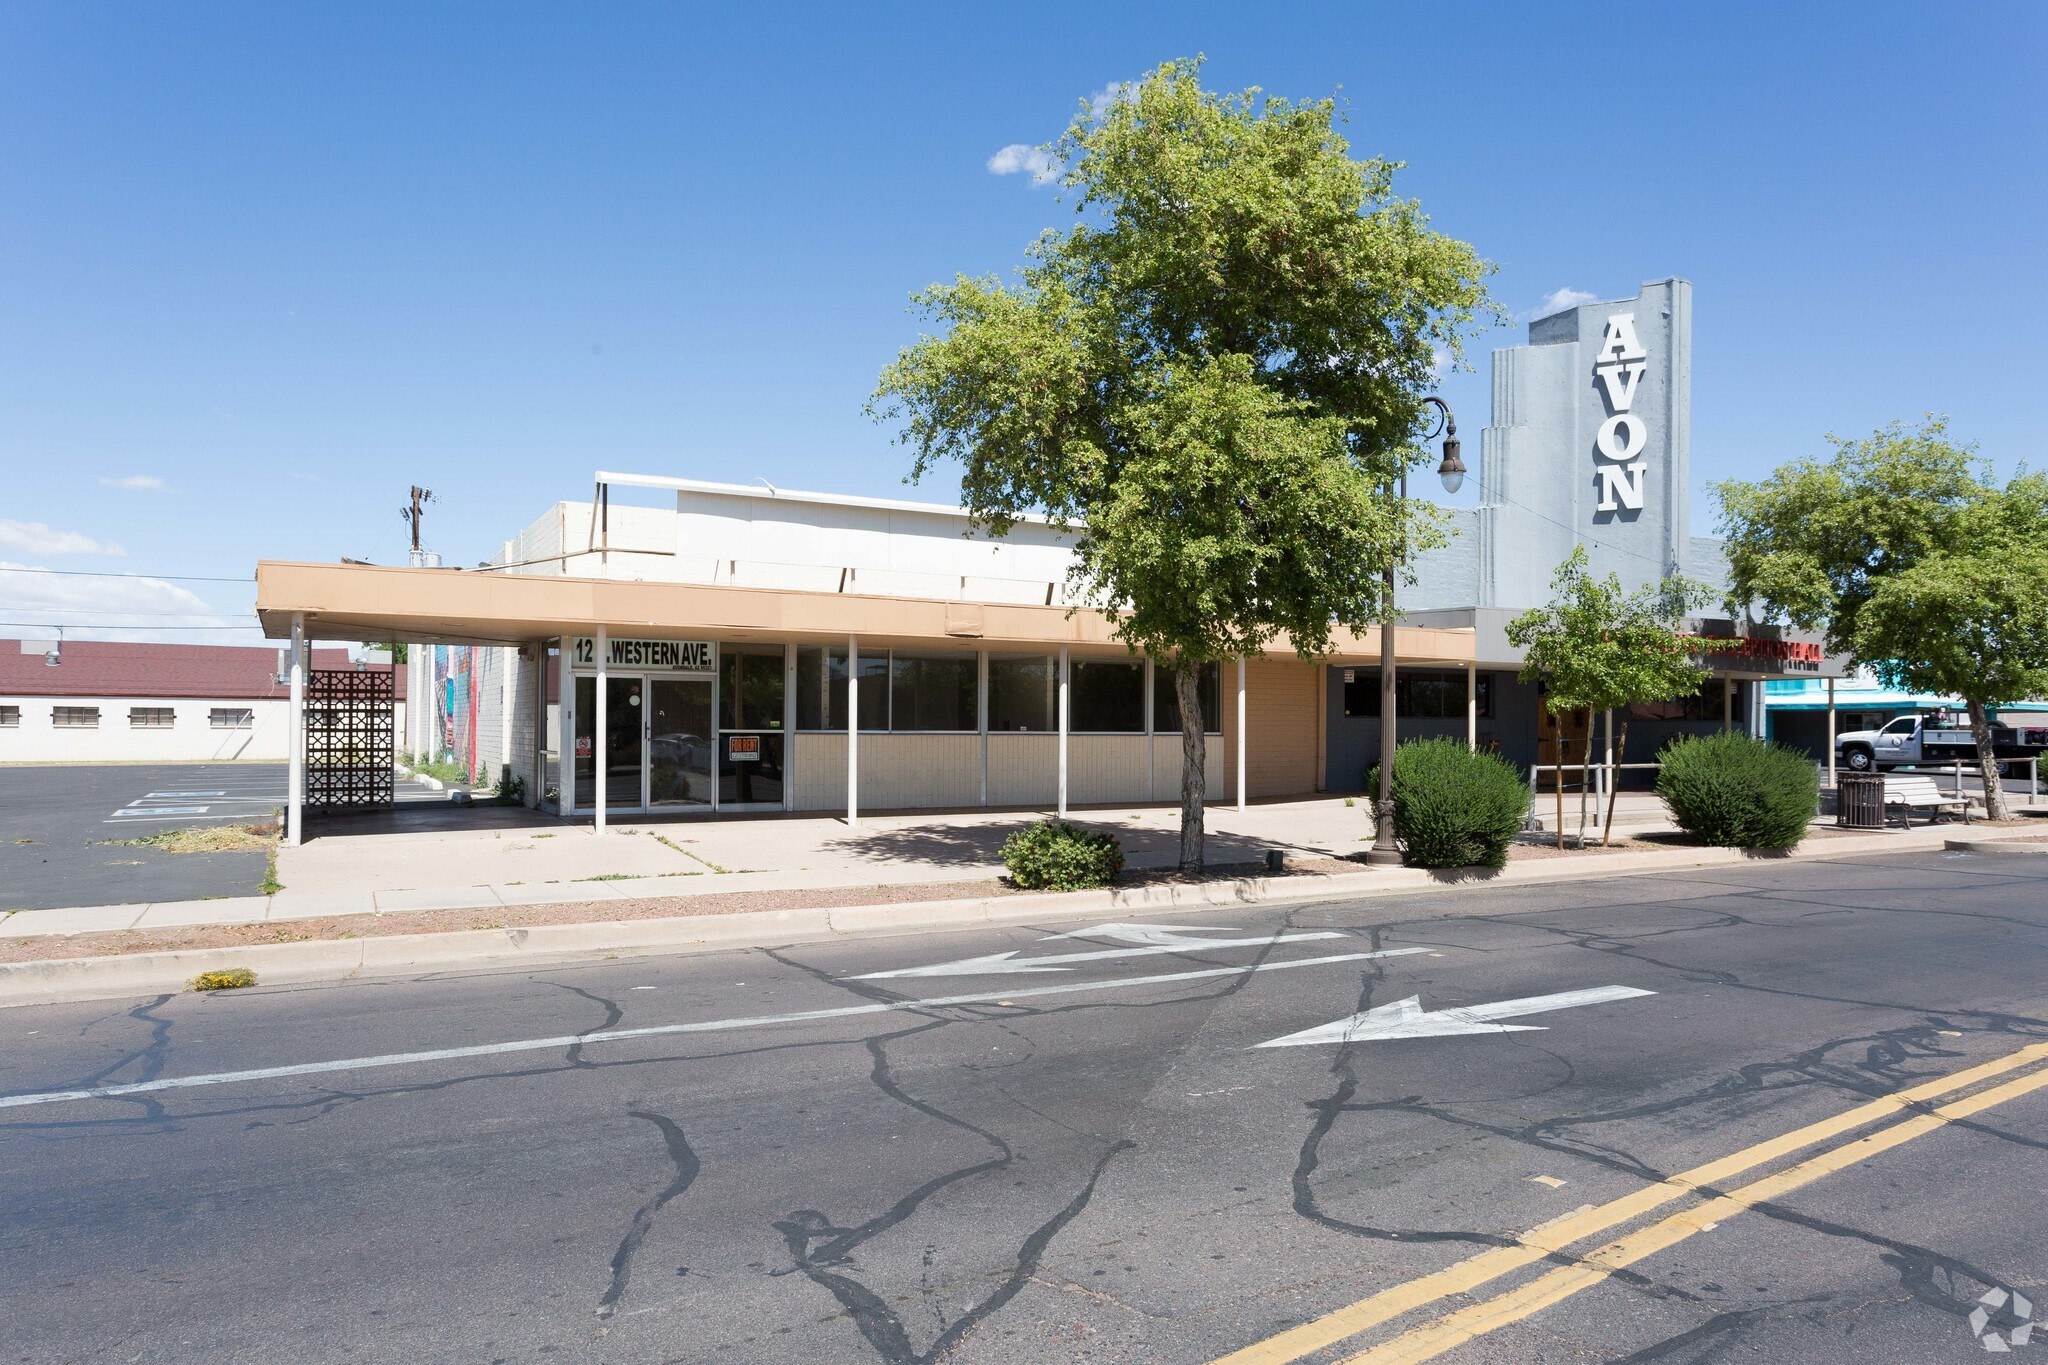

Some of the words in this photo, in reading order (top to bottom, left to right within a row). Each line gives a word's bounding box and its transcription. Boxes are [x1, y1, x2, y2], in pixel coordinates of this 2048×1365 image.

[1596, 312, 1647, 512] AVON
[576, 638, 593, 663] 12
[611, 640, 679, 665] WESTERN
[681, 643, 712, 666] AVE.
[1788, 641, 1824, 663] HALL
[732, 739, 742, 752] FOR
[743, 739, 757, 751] RENT
